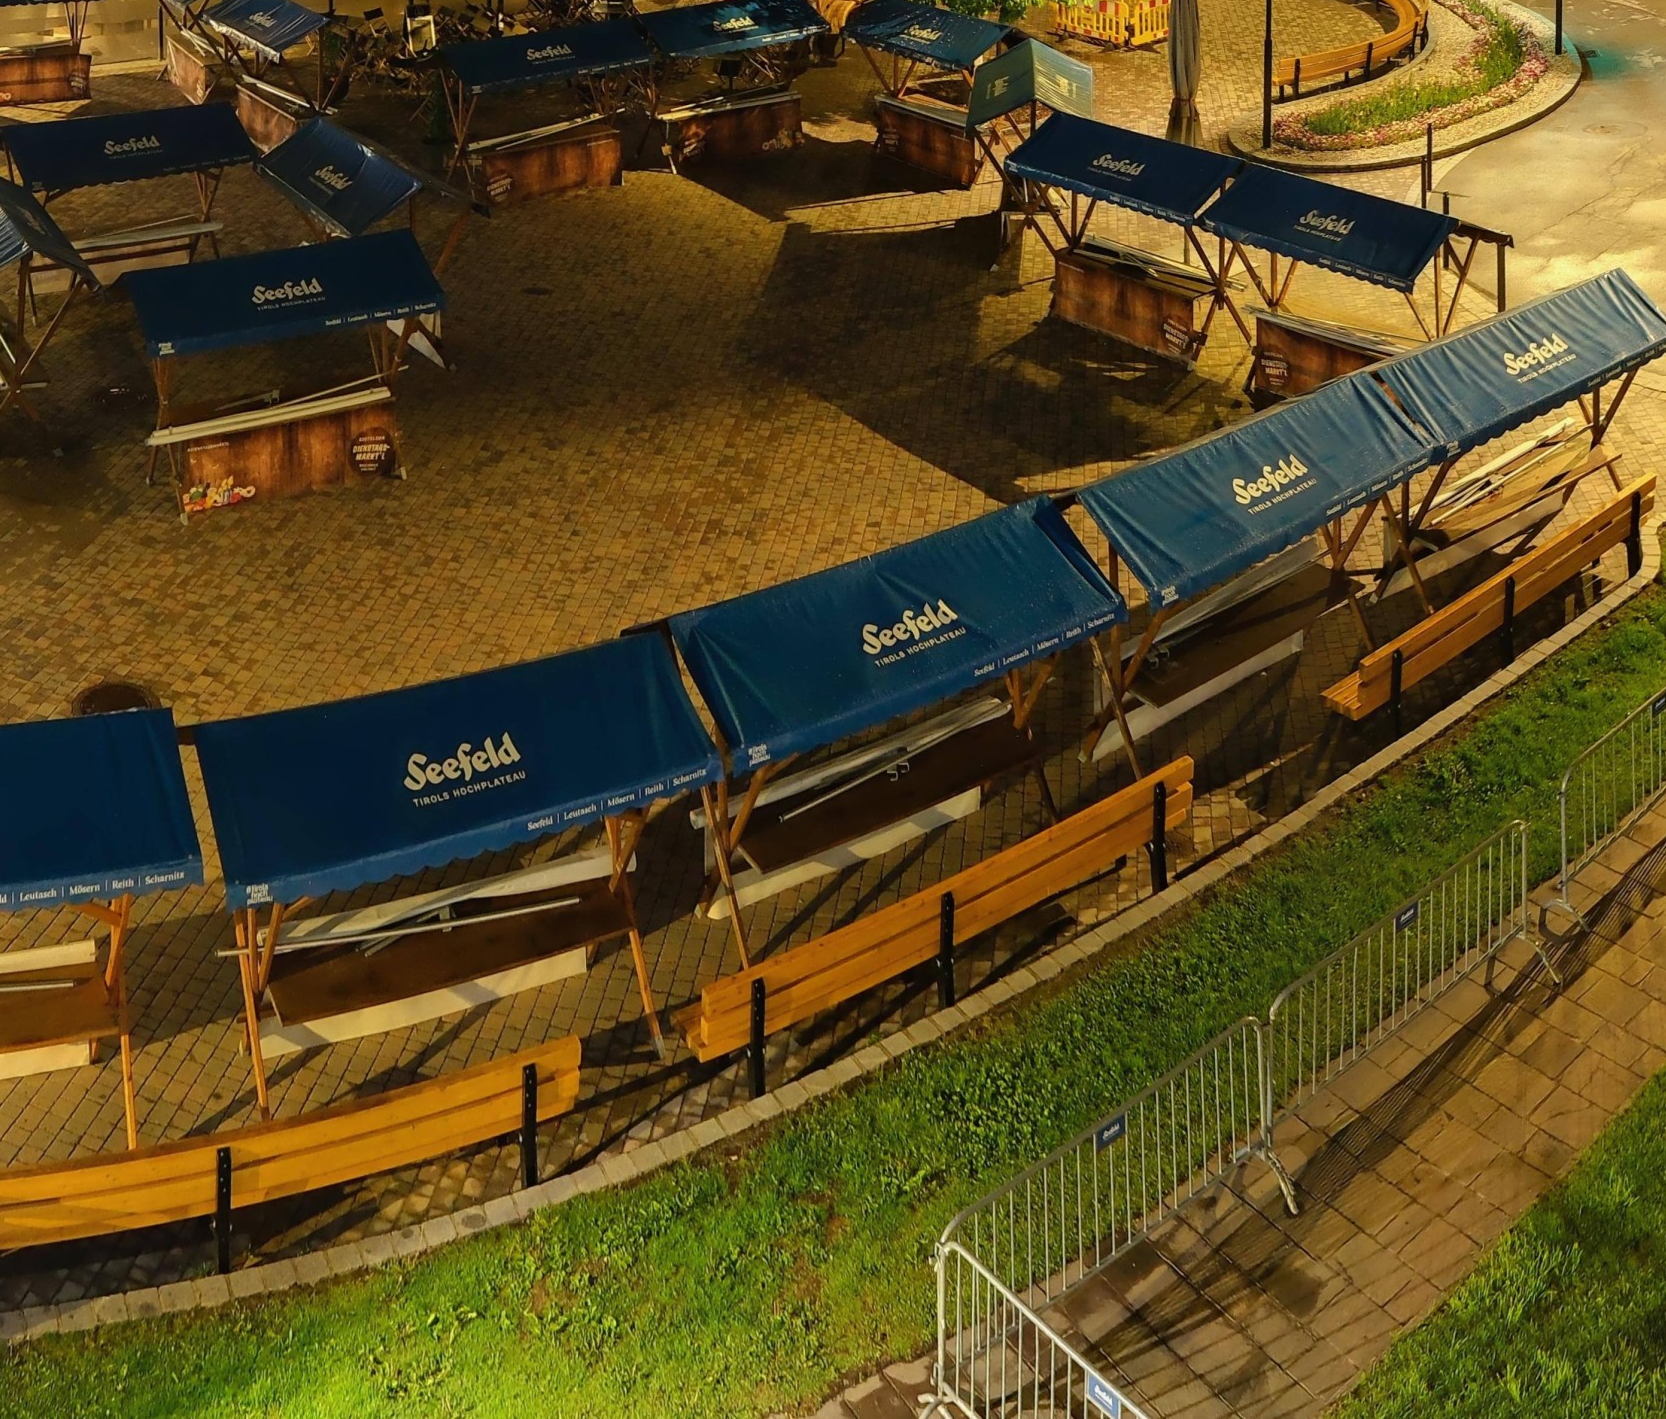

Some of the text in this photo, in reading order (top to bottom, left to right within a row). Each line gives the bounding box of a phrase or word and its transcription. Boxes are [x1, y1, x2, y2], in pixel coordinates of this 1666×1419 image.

[713, 15, 755, 32] Seefeld
[526, 43, 573, 61] Seefeld
[104, 134, 161, 156] Seefeld
[315, 164, 354, 191] Seefeld
[1093, 153, 1146, 177] Seefeld
[250, 276, 324, 305] Seefeld
[1503, 333, 1570, 377] Seefeld
[1232, 452, 1309, 506] Seefeld
[1247, 476, 1318, 515] TIROLS HOCHPLATEAU
[862, 597, 959, 656] Seefeld
[874, 626, 967, 668] TIROLS HOCHPLATEAU
[403, 730, 523, 792] Seefeld
[412, 770, 527, 808] TIROLS HOCHPLATEAU
[527, 766, 708, 831] Seefeld Leutasch Mösern Reith Scharnitz
[19, 887, 57, 903] Leutasch
[69, 881, 101, 896] Mösern
[112, 877, 135, 890] Reith
[144, 870, 186, 886] Scharnitz
